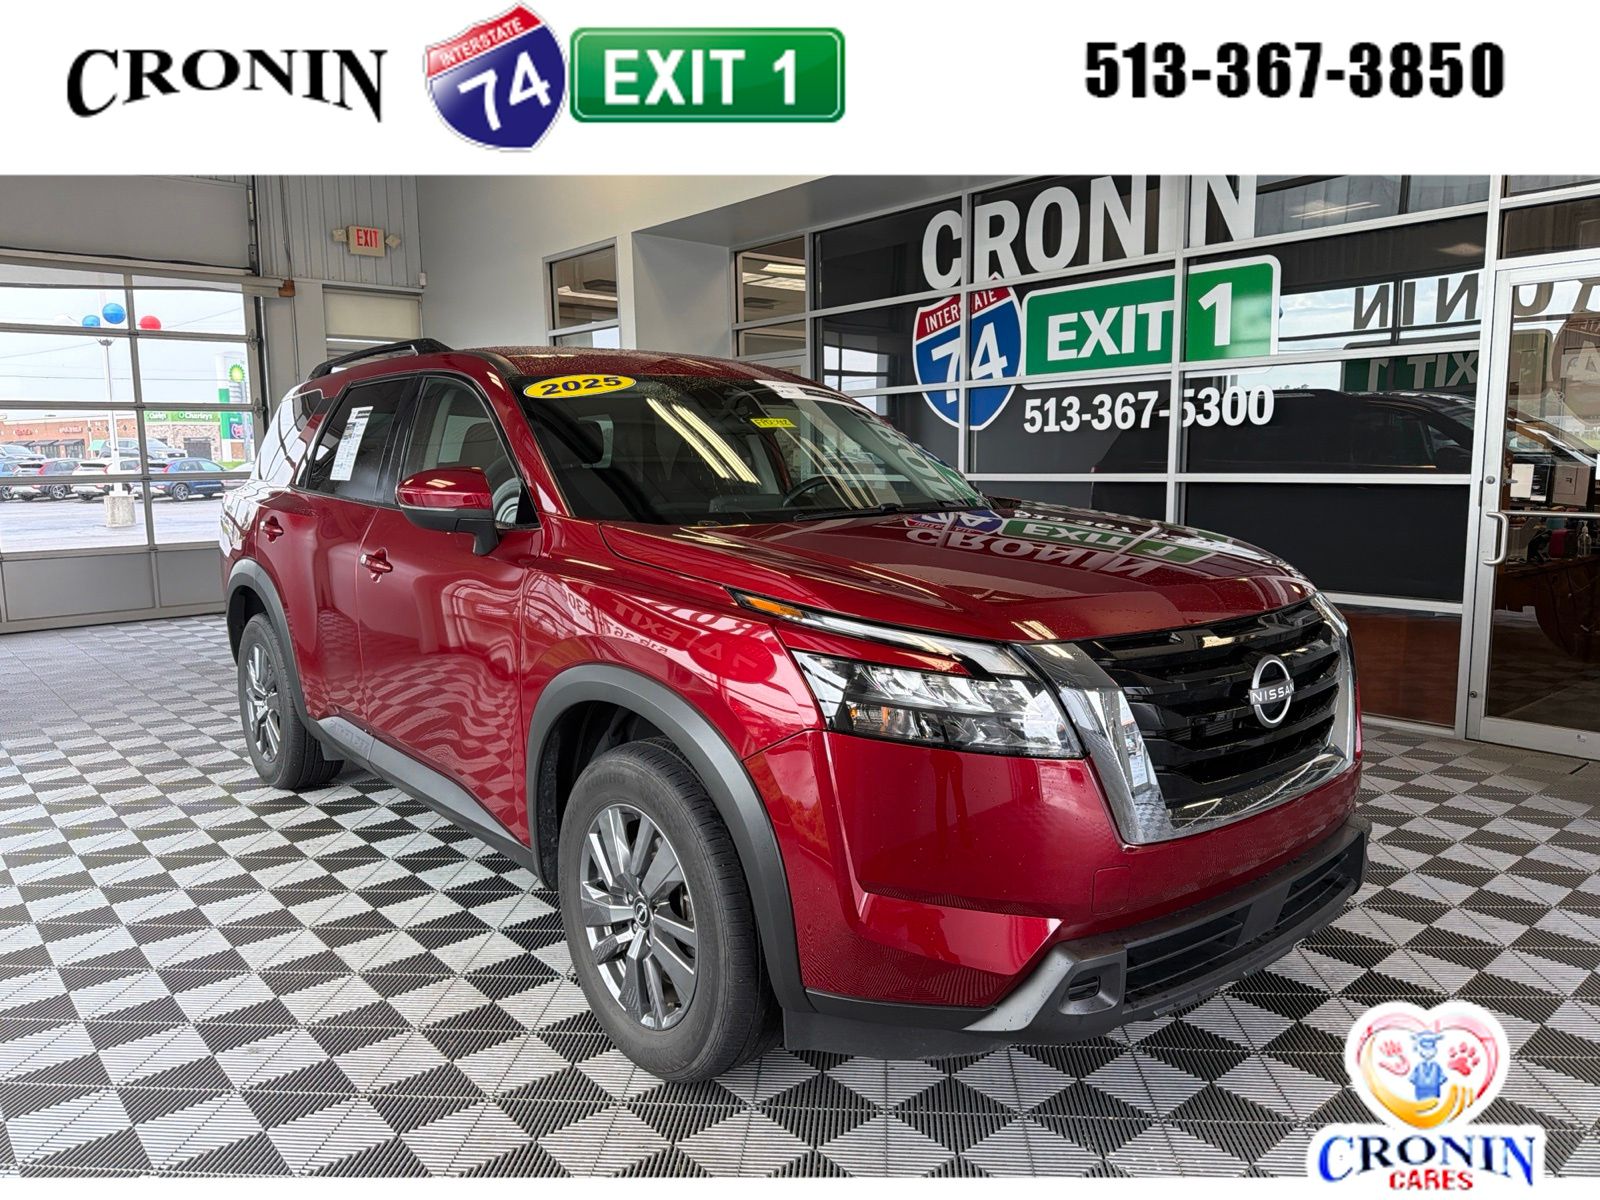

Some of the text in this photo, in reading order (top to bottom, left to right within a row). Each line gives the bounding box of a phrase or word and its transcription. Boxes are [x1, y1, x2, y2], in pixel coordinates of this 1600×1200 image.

[356, 228, 378, 248] EXIT
[922, 175, 1257, 291] CRONIN
[925, 288, 997, 333] INTERATE
[1047, 282, 1232, 361] EXIT 1
[540, 376, 622, 396] 2025
[931, 322, 1008, 404] 74
[1023, 384, 1275, 434] 513-367-5300
[1251, 682, 1294, 702] NISSAN
